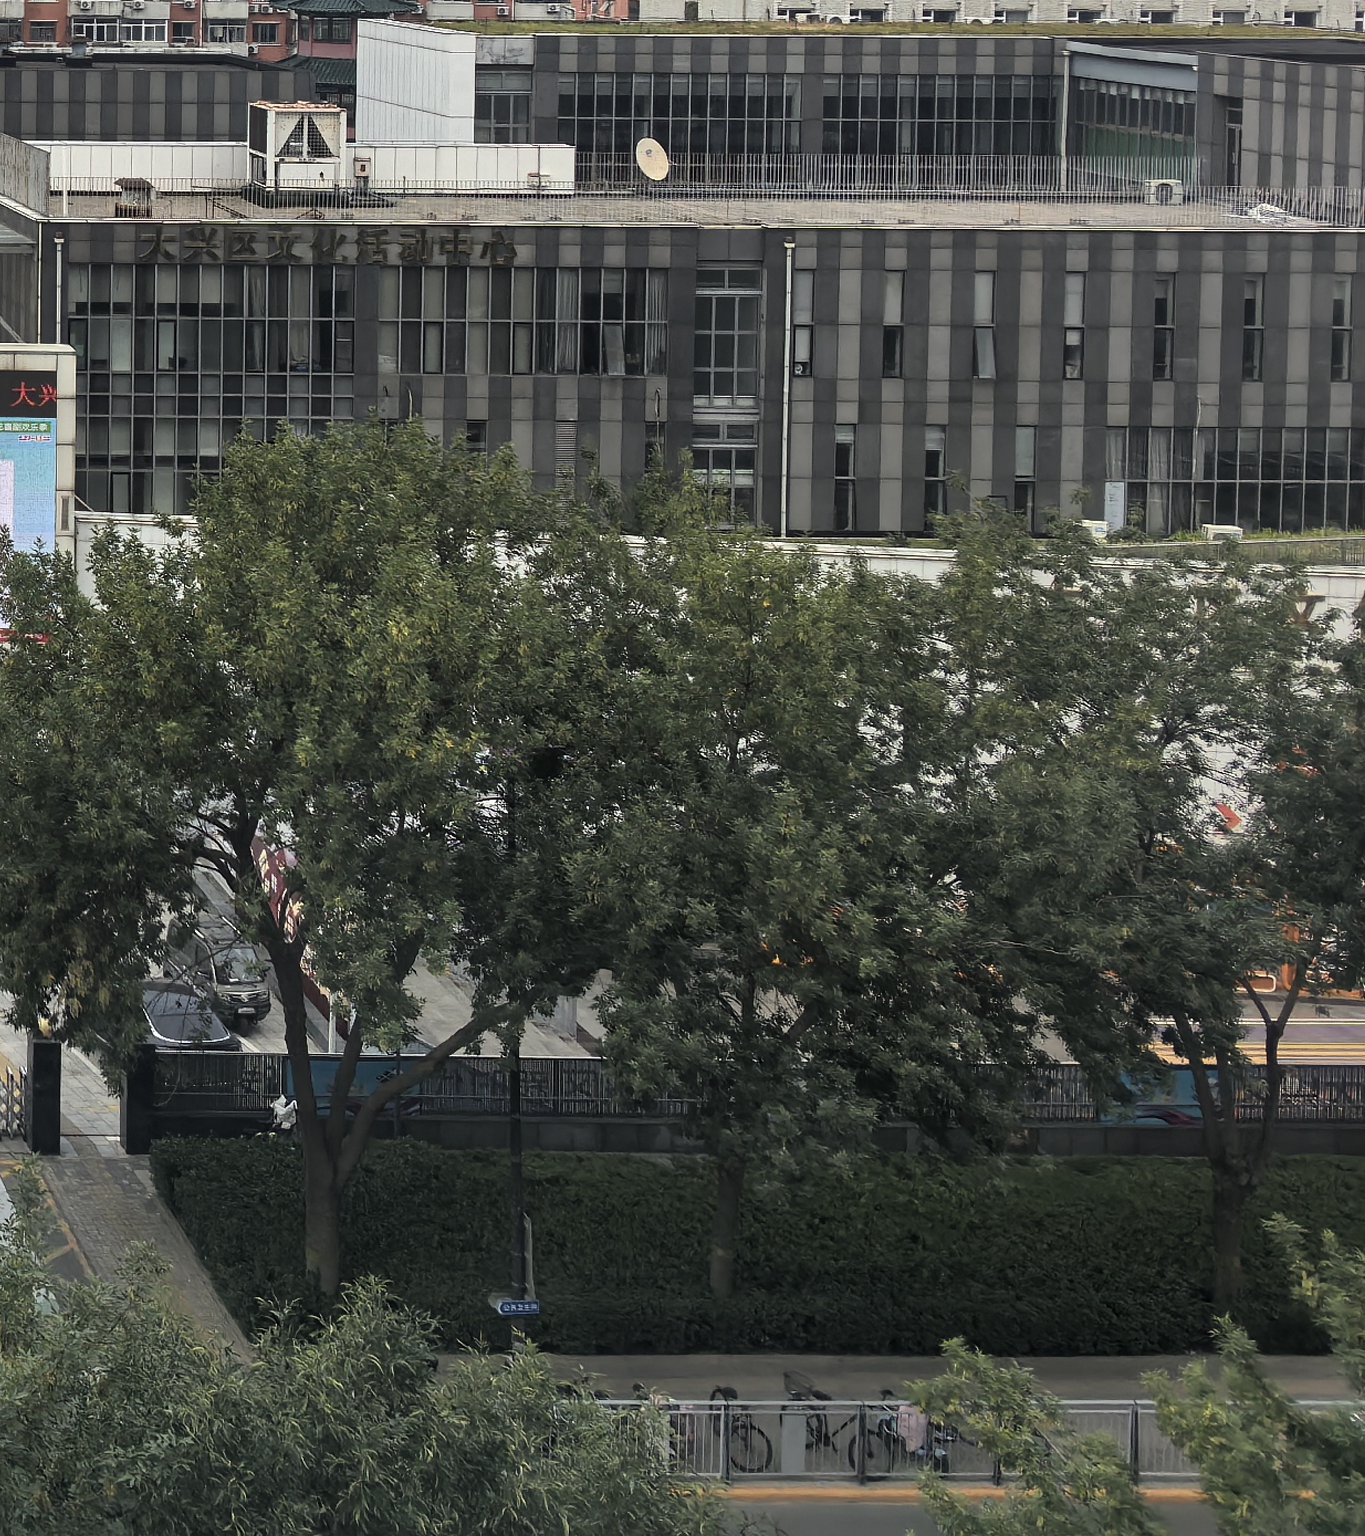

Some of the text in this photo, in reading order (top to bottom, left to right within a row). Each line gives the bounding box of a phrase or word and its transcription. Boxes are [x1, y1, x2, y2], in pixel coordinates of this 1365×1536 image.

[138, 225, 519, 263] 大兴区文化活动中心
